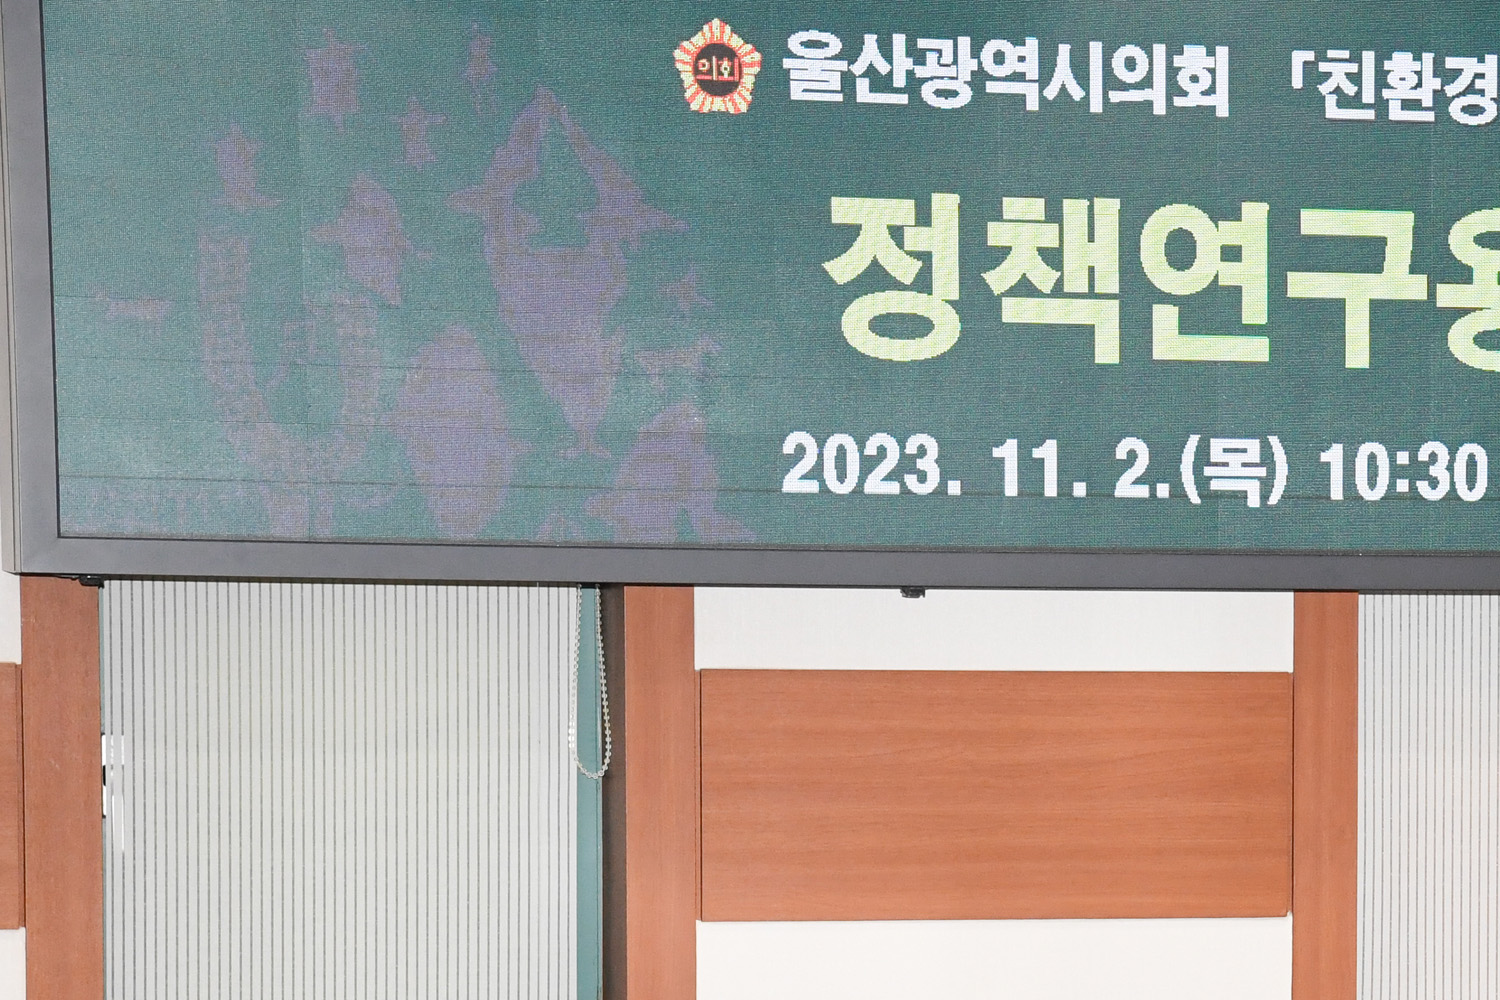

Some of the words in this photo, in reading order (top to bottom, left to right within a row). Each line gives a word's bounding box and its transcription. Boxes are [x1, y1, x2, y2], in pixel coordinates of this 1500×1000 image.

[694, 55, 740, 82] 의회
[783, 30, 1228, 117] 울산광역시의회
[782, 432, 961, 495] 2023.
[993, 439, 1086, 497] 11.
[1115, 435, 1288, 507] 2.(목)
[1320, 442, 1487, 501] 10:30
